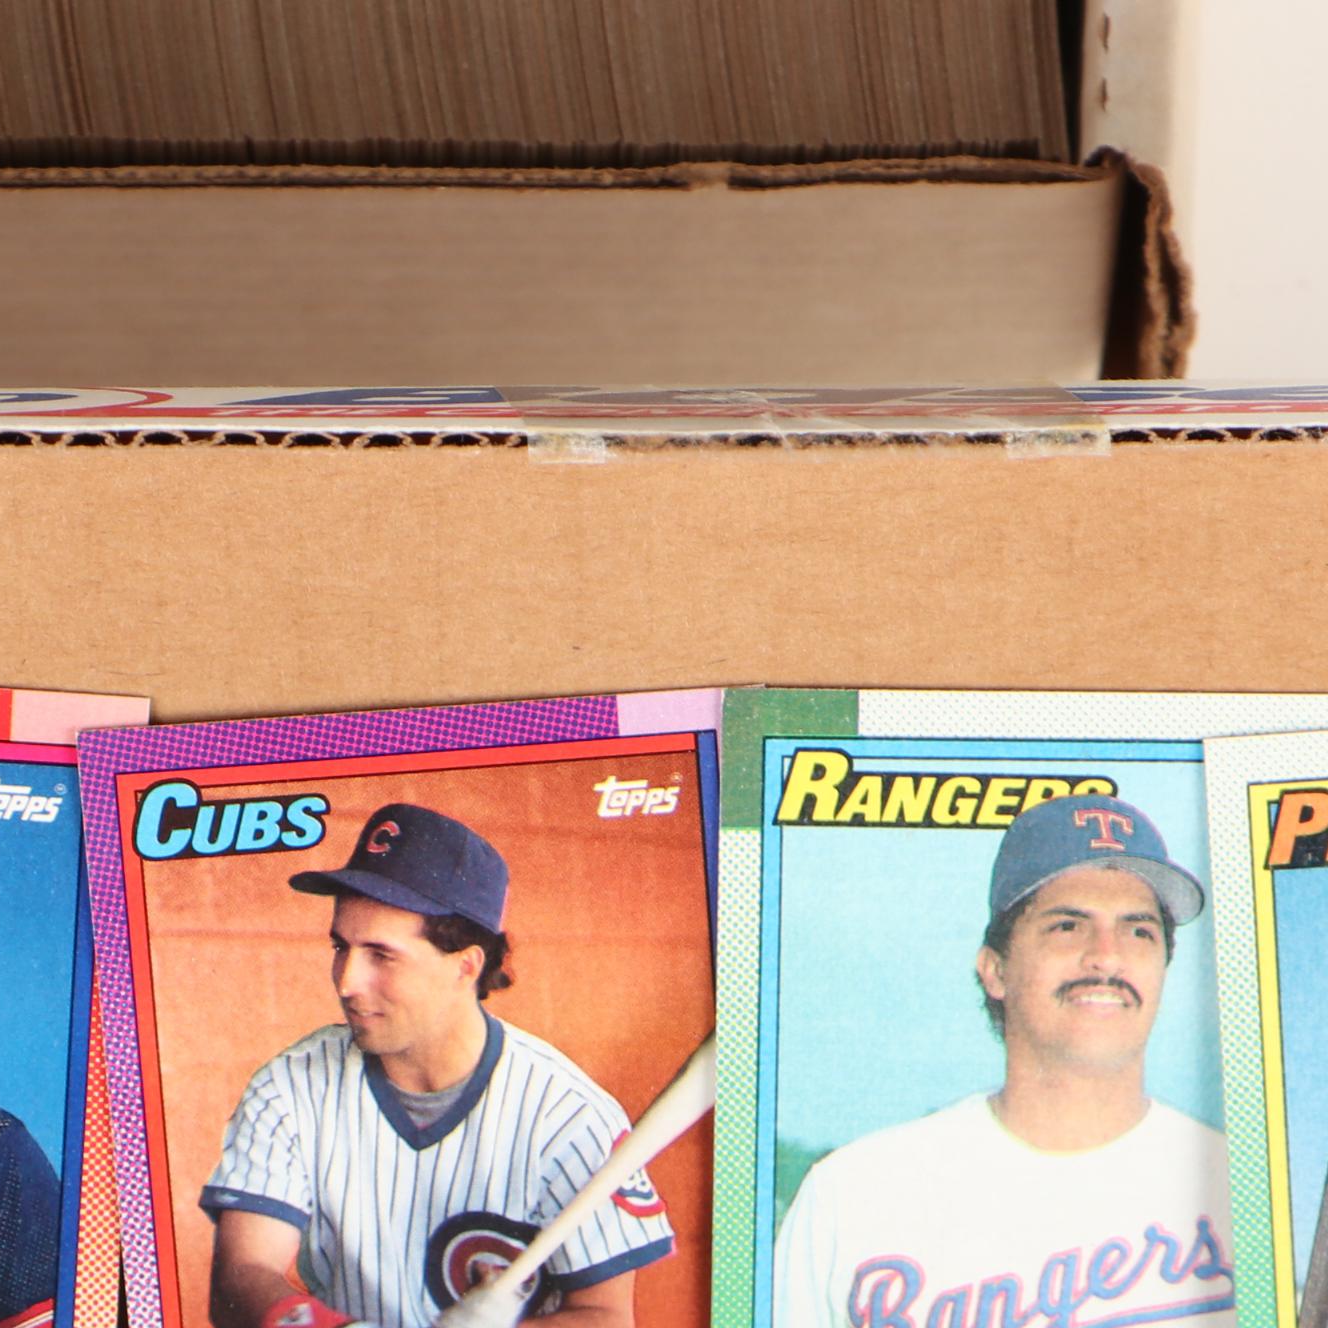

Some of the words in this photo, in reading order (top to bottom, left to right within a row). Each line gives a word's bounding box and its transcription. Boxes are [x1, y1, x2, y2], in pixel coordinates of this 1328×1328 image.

[210, 408, 402, 416] THE
[135, 781, 326, 859] CUBS
[1074, 808, 1136, 852] T
